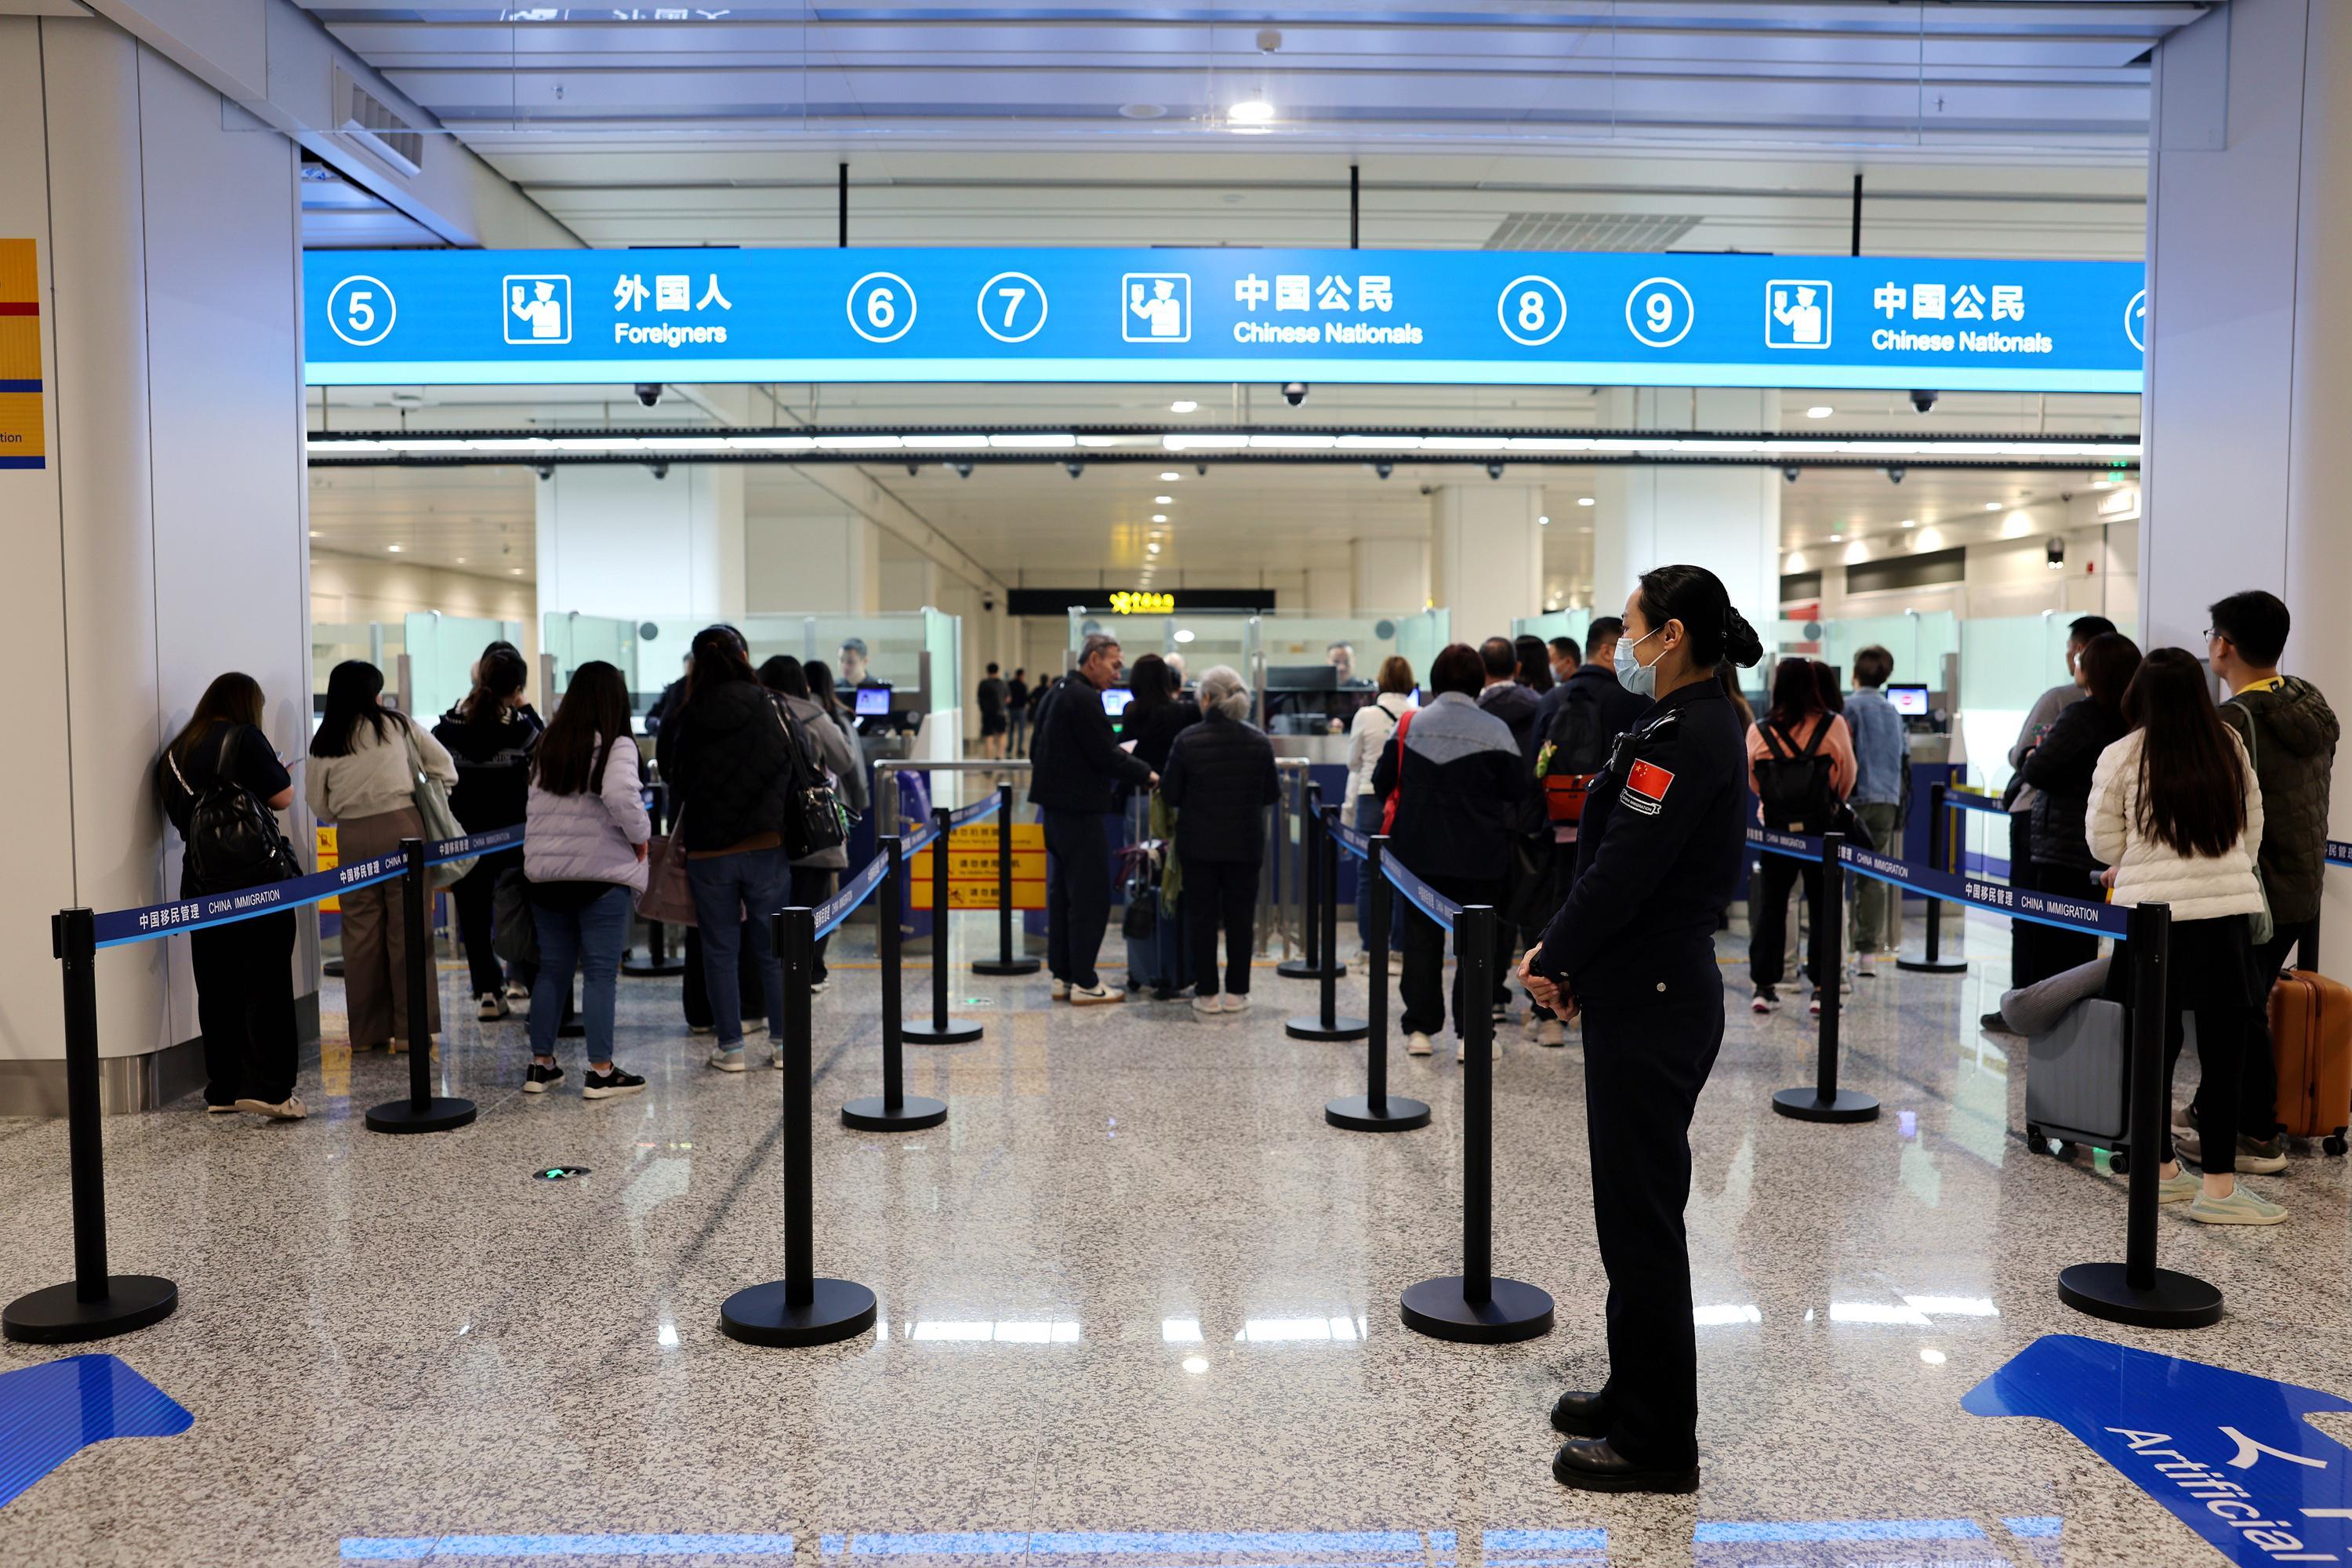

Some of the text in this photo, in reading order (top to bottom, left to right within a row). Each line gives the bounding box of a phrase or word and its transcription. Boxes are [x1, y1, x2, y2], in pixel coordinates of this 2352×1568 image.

[614, 274, 732, 312] 外国人
[1235, 274, 1393, 312] 中国公民
[1874, 282, 2025, 321] 中国公民
[348, 291, 375, 332] 5
[866, 287, 895, 328] 6
[998, 288, 1026, 328] 7
[1517, 290, 1545, 332] 8
[1645, 292, 1673, 333] 9
[615, 322, 728, 348] Foreigners
[1233, 321, 1424, 344] Chinese Nationals
[1872, 329, 2053, 354] Chinese Nationals
[339, 860, 380, 884] 中国移民管理
[385, 855, 401, 869] CHINA
[1857, 852, 1873, 867] CHINA
[1874, 858, 1908, 878] IMMIGRATION
[209, 889, 281, 914] CHINA IMMIGRATION
[1965, 882, 2013, 906] 中国移民管理
[139, 903, 200, 930] 中国移民管理
[2021, 895, 2099, 922] CHINA IMMIGRATION
[2103, 1425, 2340, 1563] Artificial
